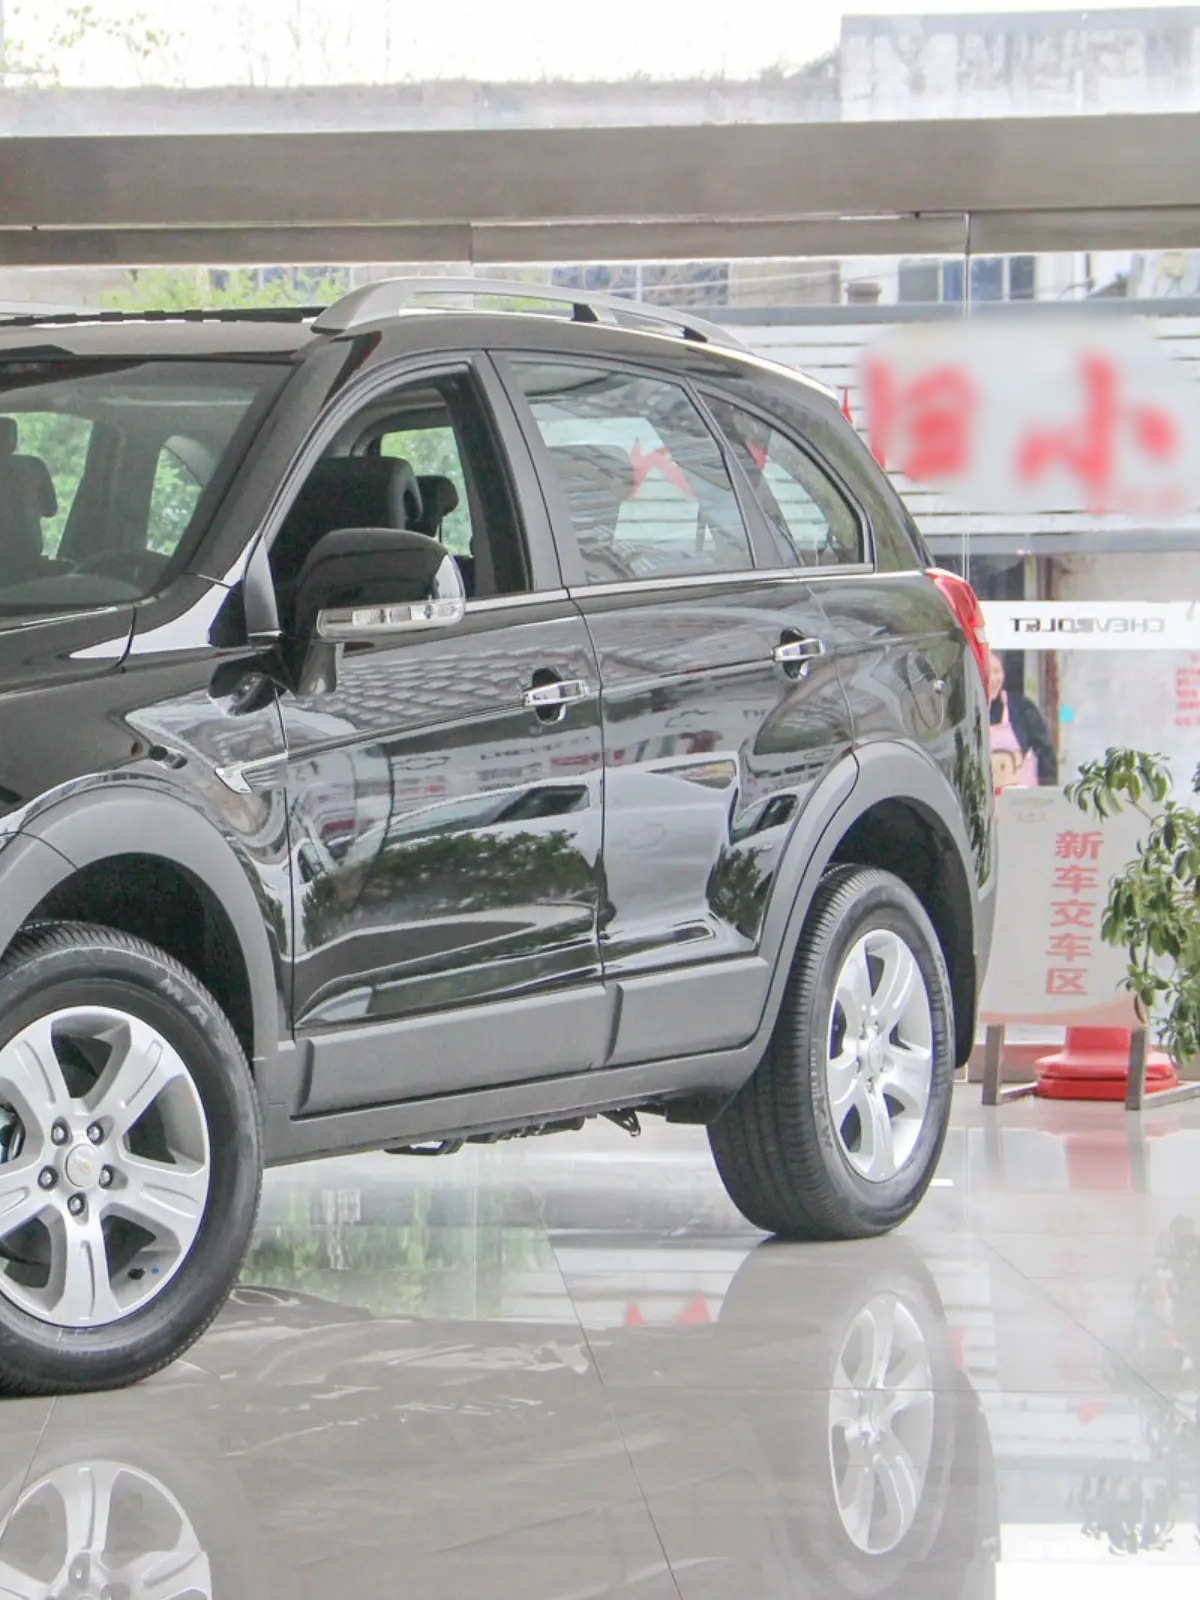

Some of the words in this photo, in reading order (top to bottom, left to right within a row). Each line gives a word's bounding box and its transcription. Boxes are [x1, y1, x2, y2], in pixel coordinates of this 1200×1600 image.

[1045, 830, 1104, 995] 新车交车区
